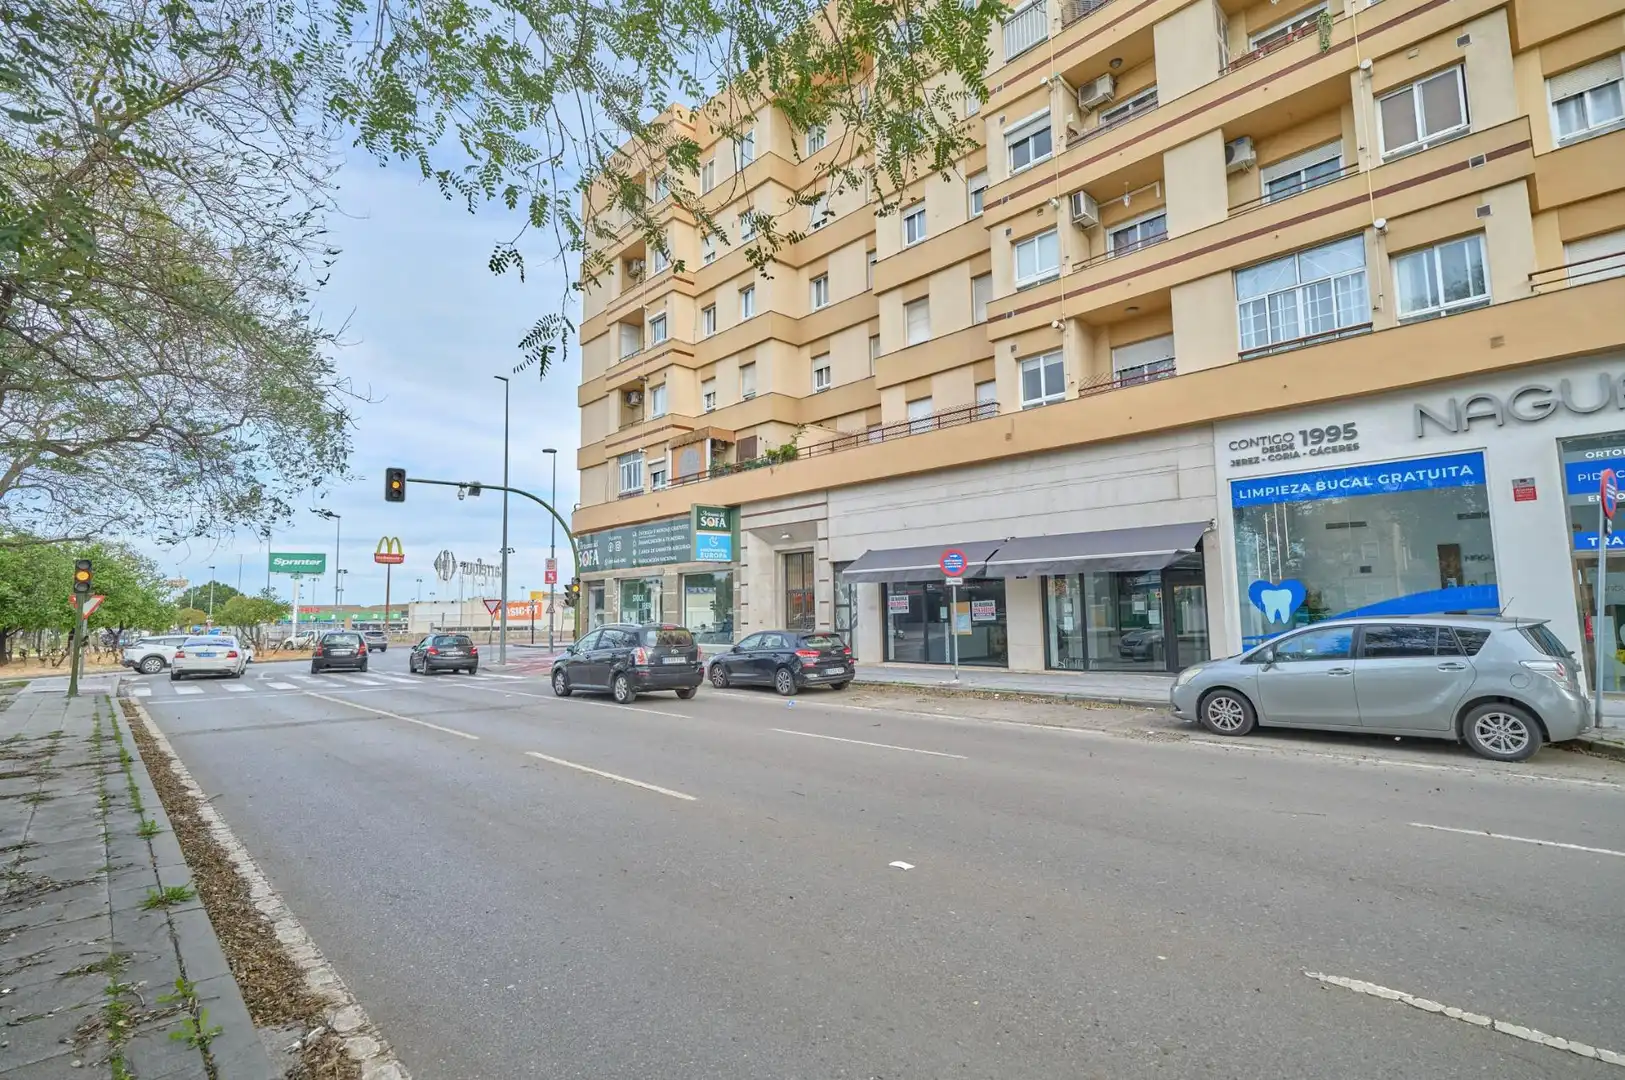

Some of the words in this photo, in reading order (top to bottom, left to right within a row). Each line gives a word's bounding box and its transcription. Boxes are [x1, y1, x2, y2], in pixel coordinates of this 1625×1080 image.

[1413, 372, 1625, 438] NAGU
[1228, 432, 1295, 452] CONTIGO
[1298, 422, 1358, 447] 1995
[1230, 455, 1260, 467] JEREZ
[1267, 450, 1301, 462] CORIA
[1308, 442, 1360, 457] CÁCERES
[1261, 442, 1296, 454] DESDE
[1238, 483, 1312, 499] LIMPIEZA
[1315, 476, 1374, 491] BUCAL
[1377, 464, 1474, 484] GRATUITA
[1577, 472, 1603, 482] PID
[700, 516, 727, 528] SOFA
[273, 557, 323, 567] Sprinter
